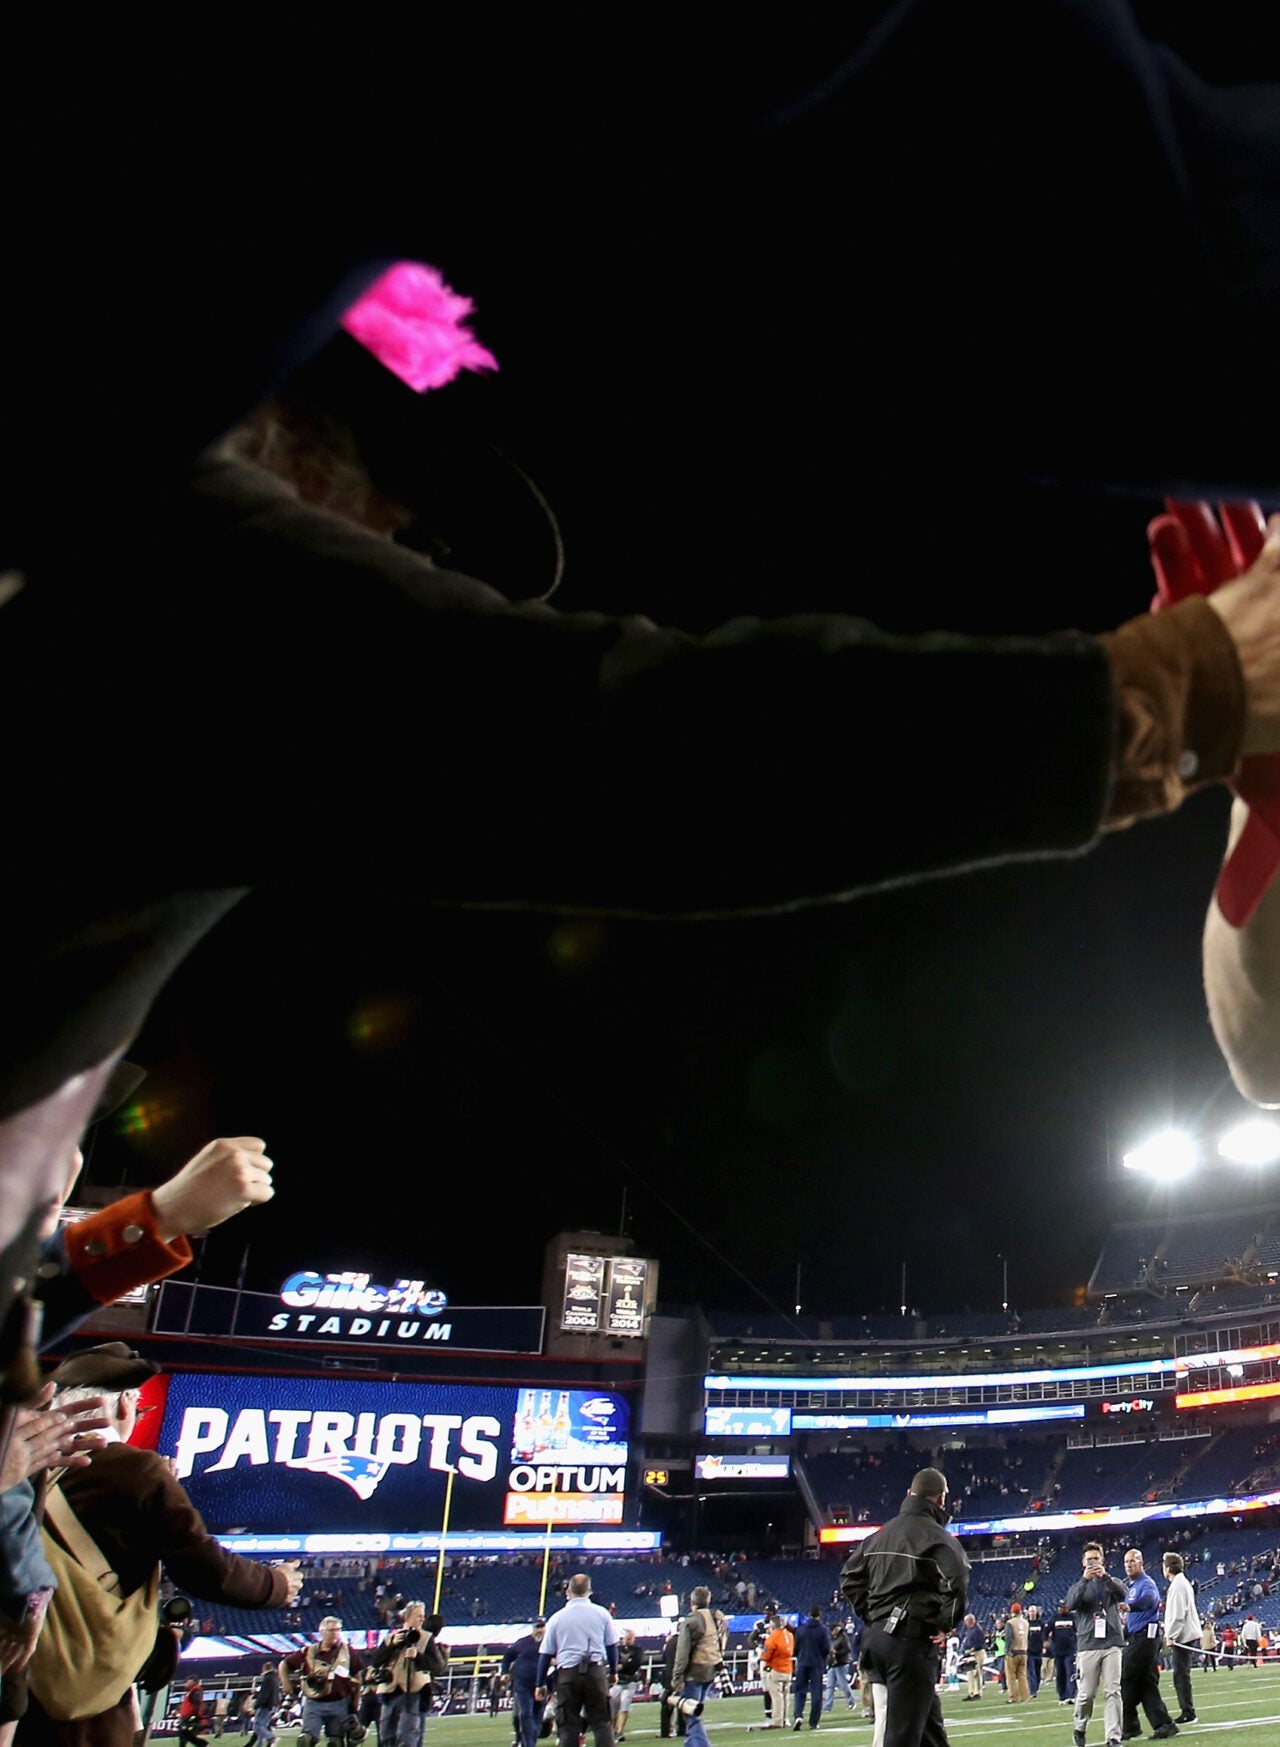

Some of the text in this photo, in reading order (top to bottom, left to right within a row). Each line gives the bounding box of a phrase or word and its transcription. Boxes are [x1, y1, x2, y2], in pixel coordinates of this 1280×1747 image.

[280, 1270, 448, 1318] Gillette
[267, 1313, 452, 1341] STADIUM
[564, 1316, 597, 1327] 2004
[610, 1319, 640, 1330] 2014
[174, 1406, 500, 1482] PATRIOTS
[508, 1465, 626, 1493] OPTUM
[645, 1470, 667, 1485] 25
[505, 1495, 624, 1521] Putnam
